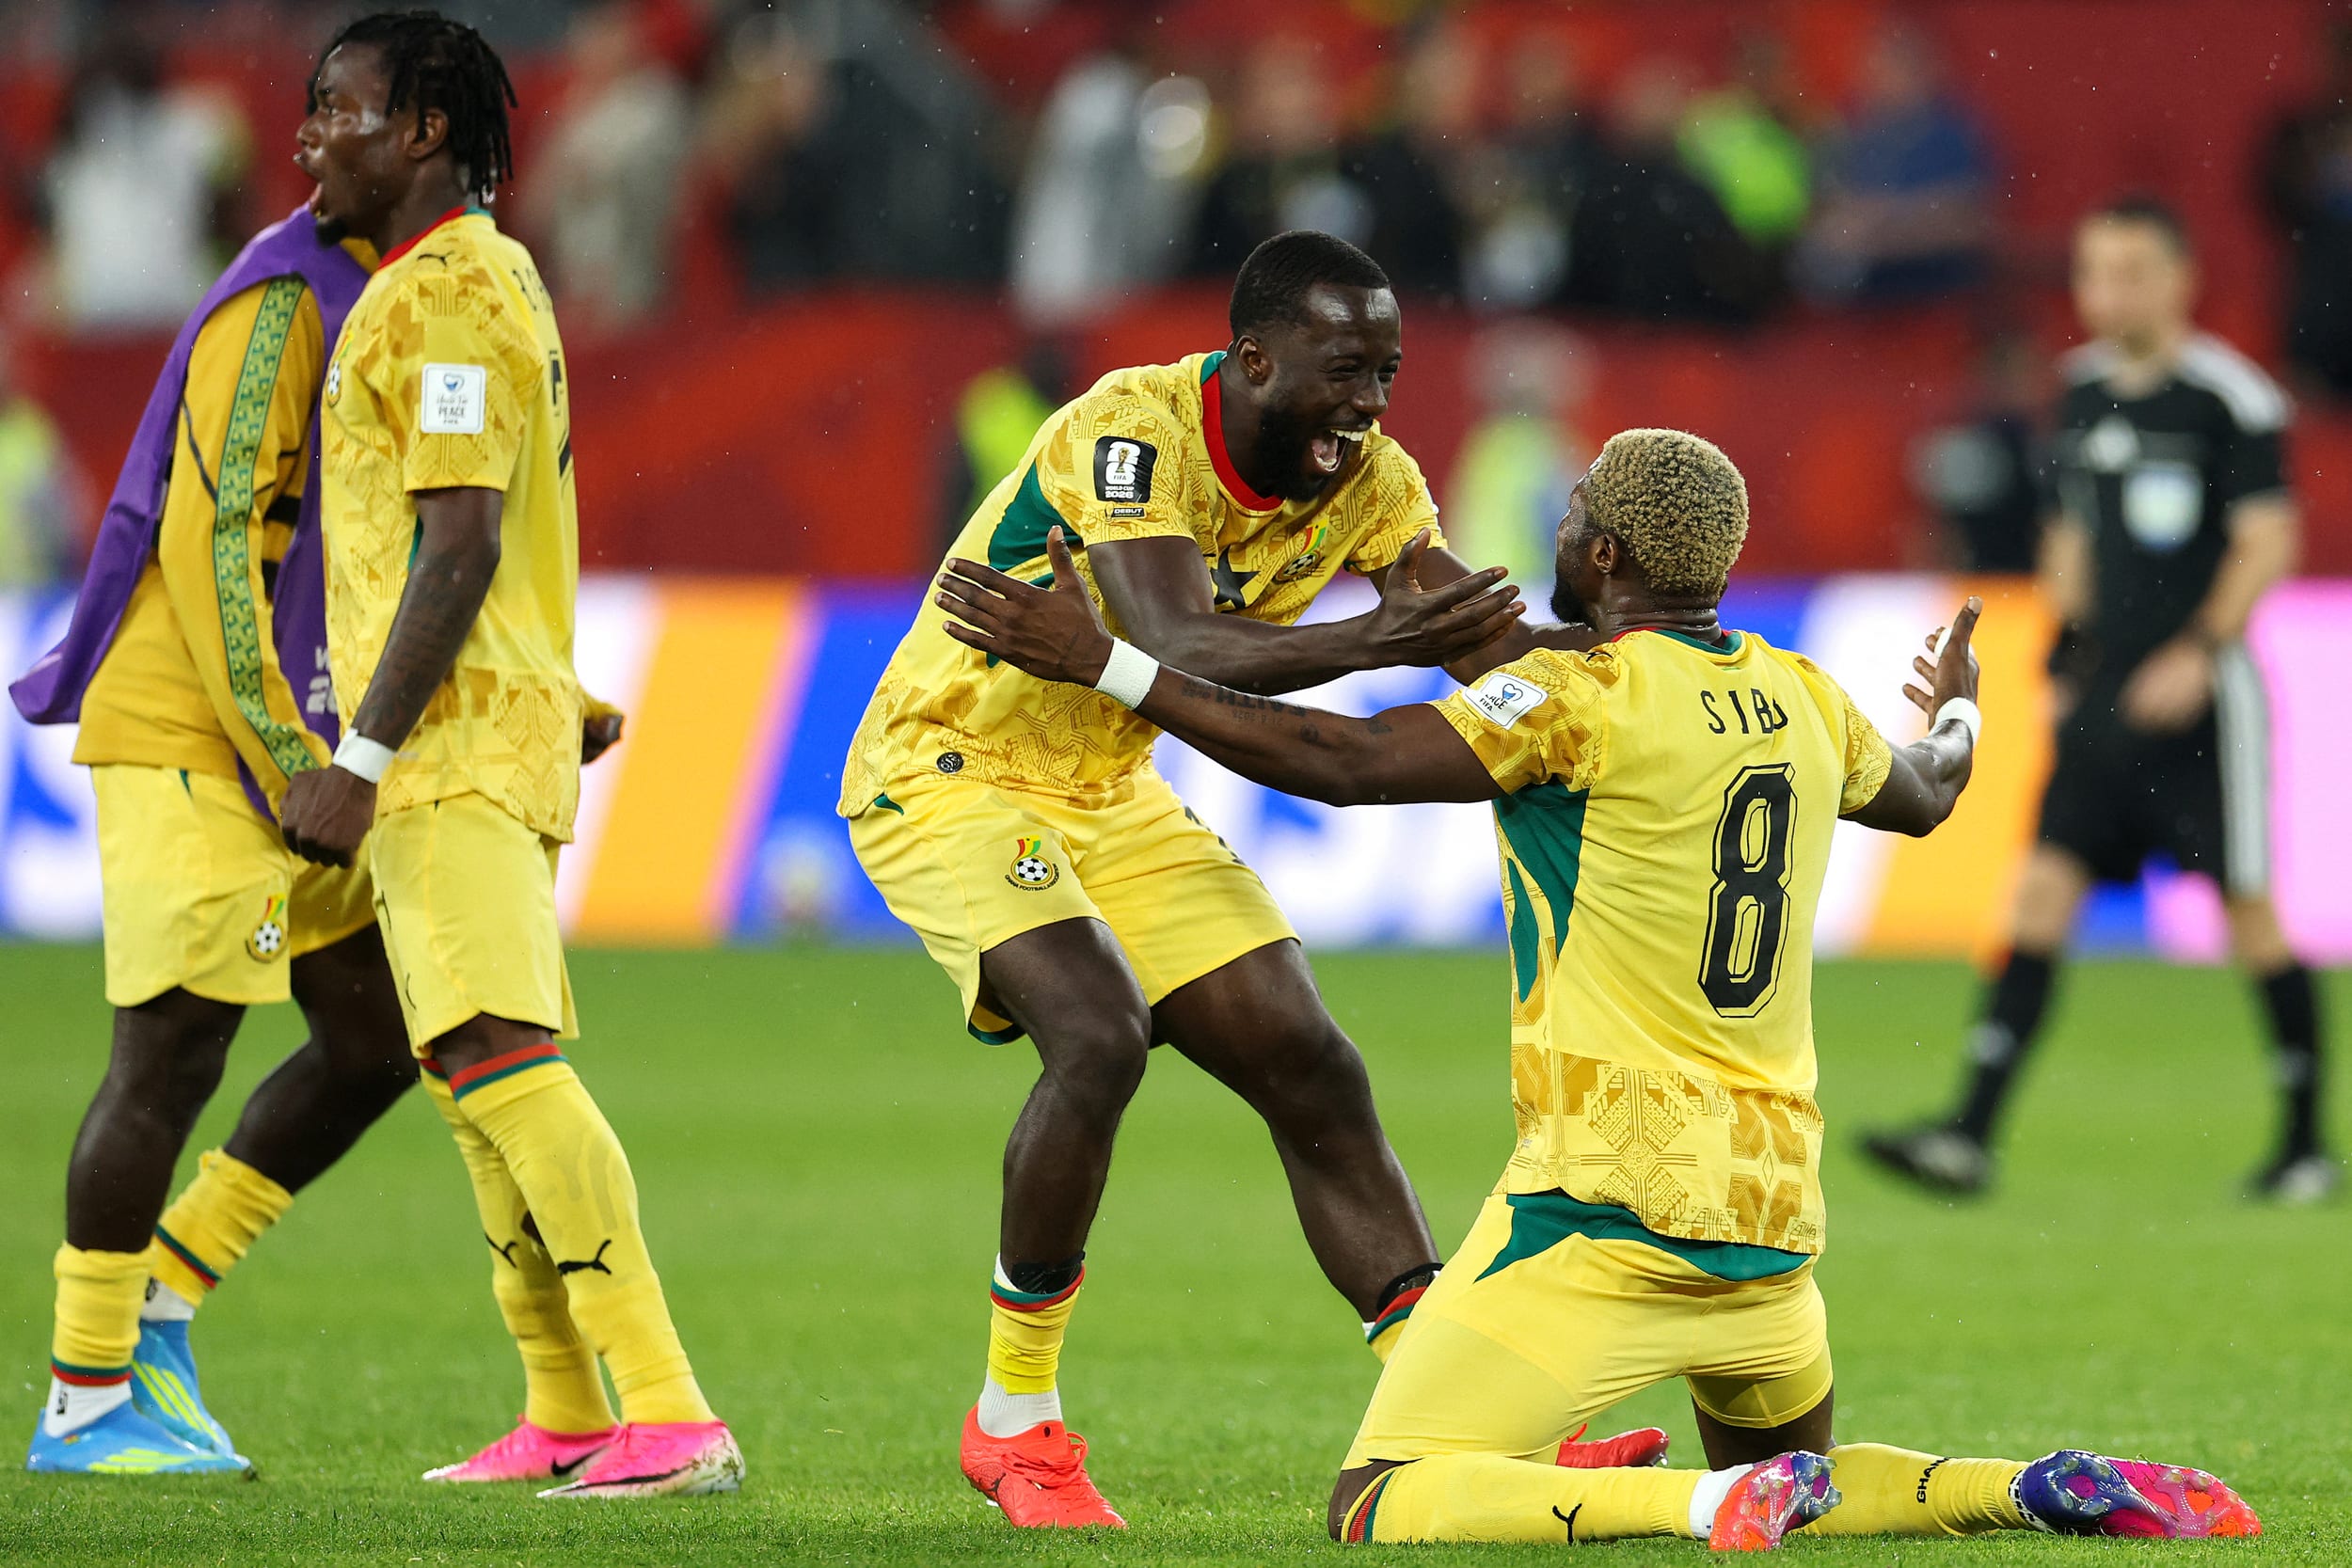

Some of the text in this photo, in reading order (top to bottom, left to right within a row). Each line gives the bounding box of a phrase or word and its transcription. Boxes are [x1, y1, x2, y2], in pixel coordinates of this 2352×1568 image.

[1104, 490, 1134, 499] 2026
[1478, 697, 1493, 711] FIFA
[1697, 762, 1798, 1018] 8
